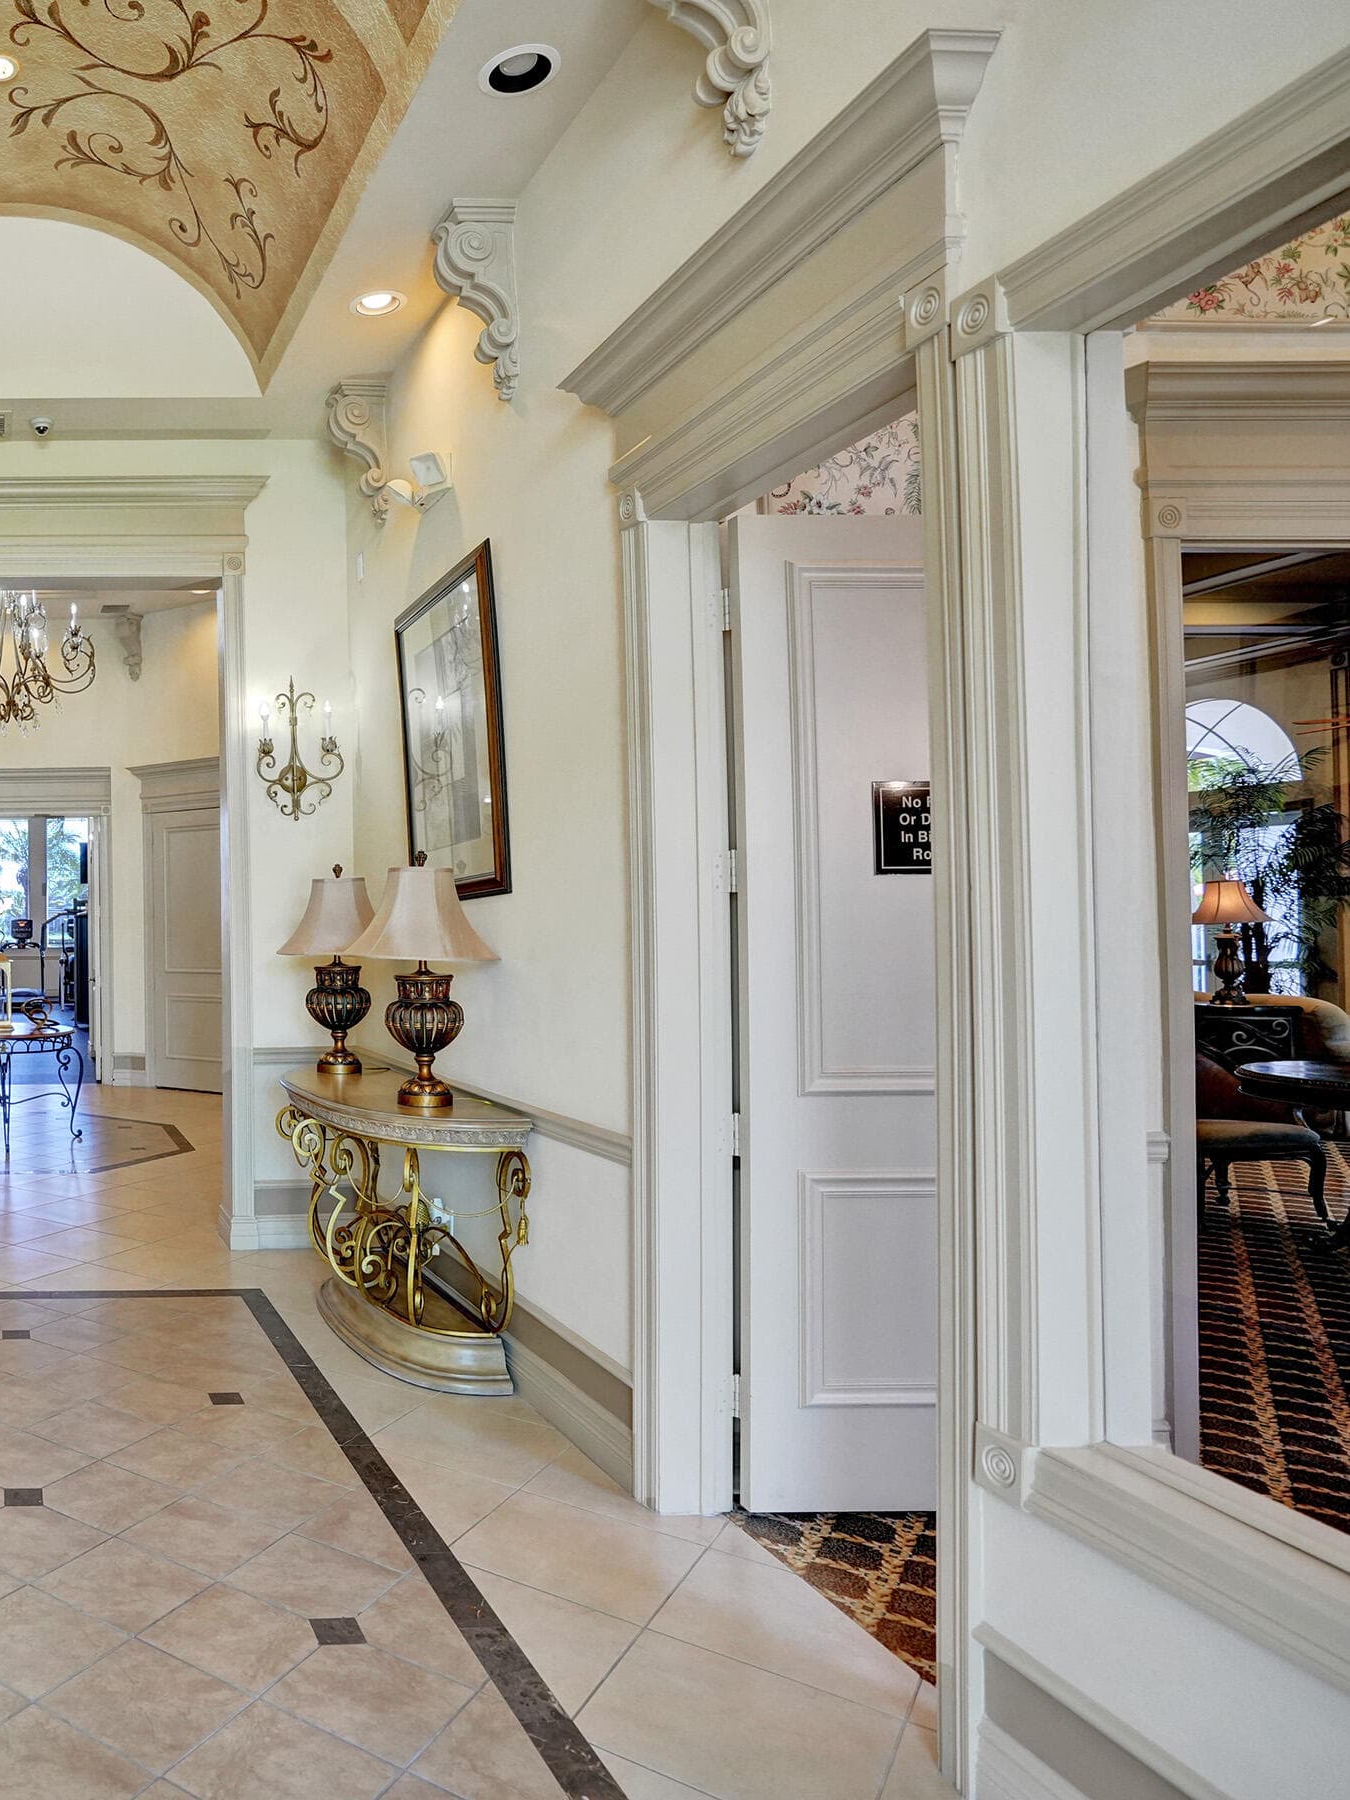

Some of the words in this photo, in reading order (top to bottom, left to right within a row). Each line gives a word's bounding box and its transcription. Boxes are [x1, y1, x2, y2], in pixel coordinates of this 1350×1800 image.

[902, 796, 922, 808] No
[899, 813, 917, 825] Or
[901, 831, 913, 842] In
